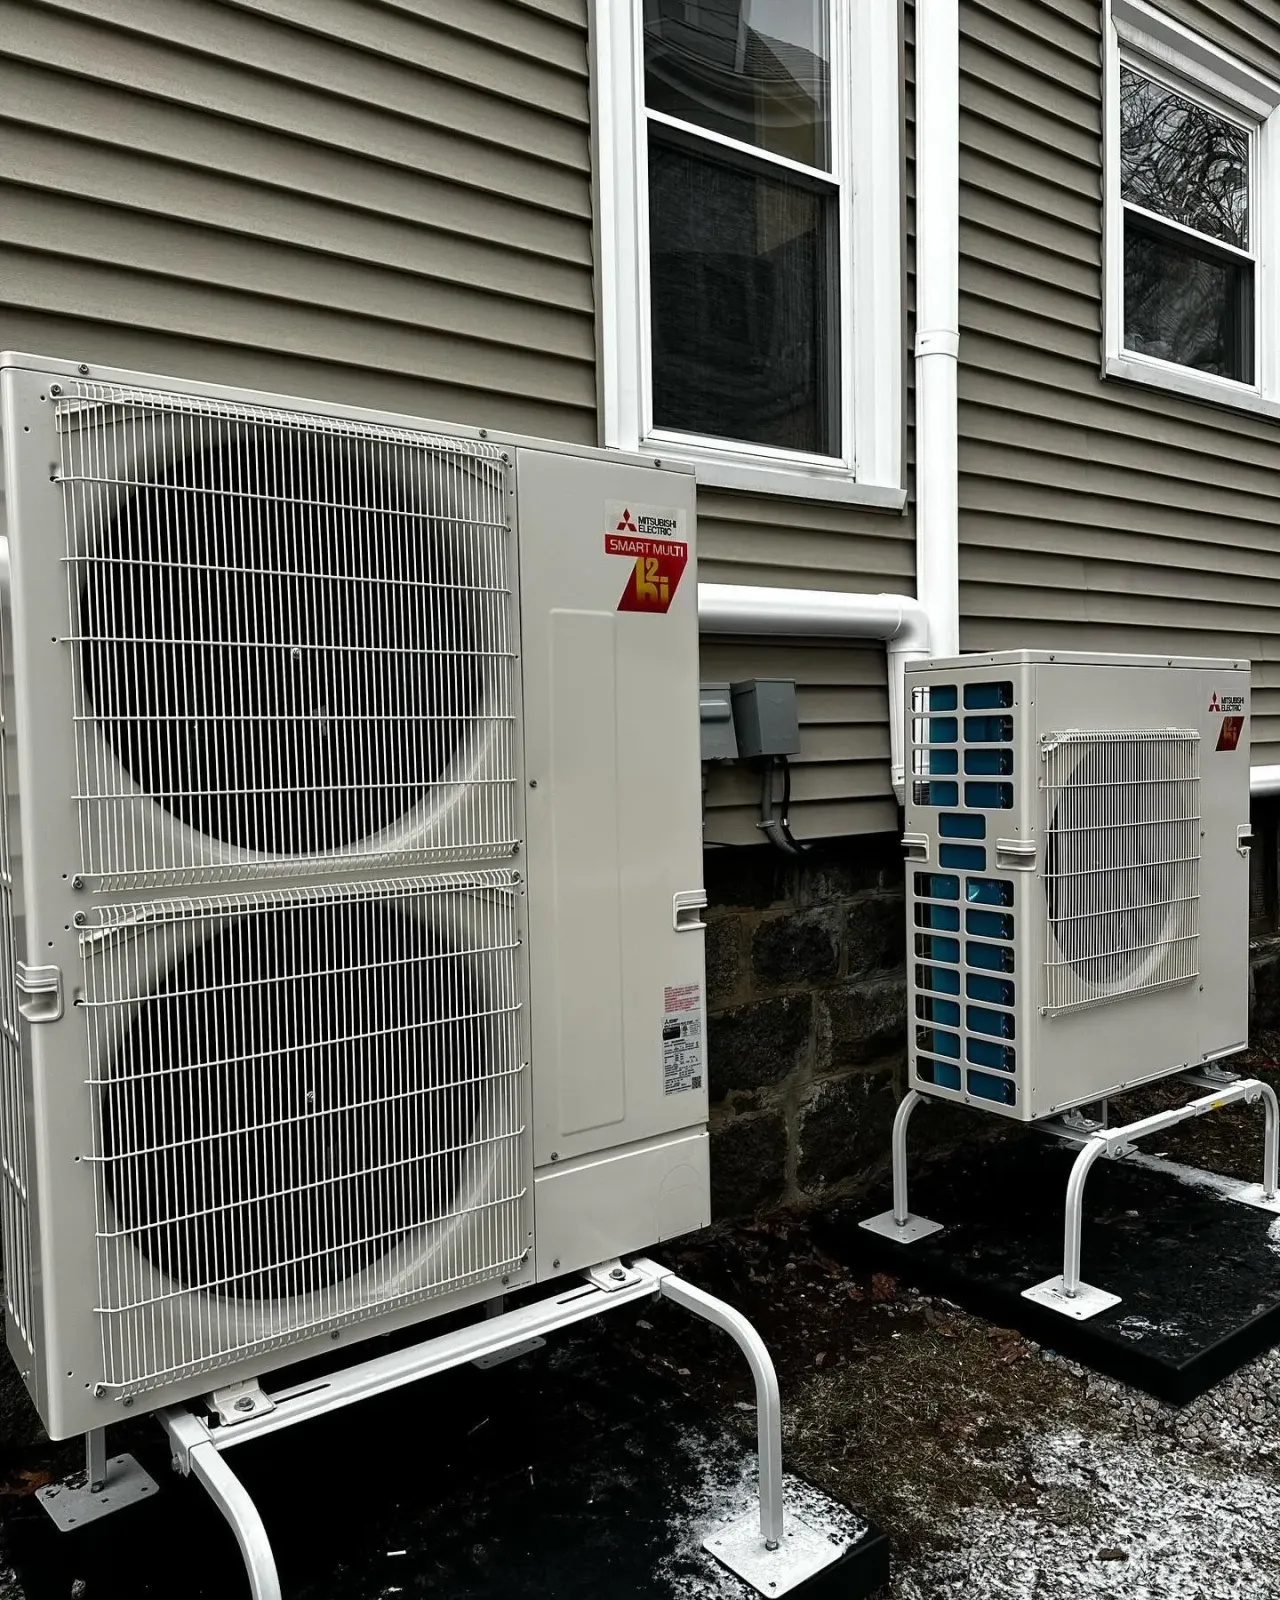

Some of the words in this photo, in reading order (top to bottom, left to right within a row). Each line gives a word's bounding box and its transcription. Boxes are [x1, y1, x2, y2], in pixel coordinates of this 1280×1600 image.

[638, 516, 676, 528] MITSUBISHI
[638, 525, 672, 536] ELECTRIC
[610, 539, 651, 554] SMART
[652, 544, 684, 557] MULTI
